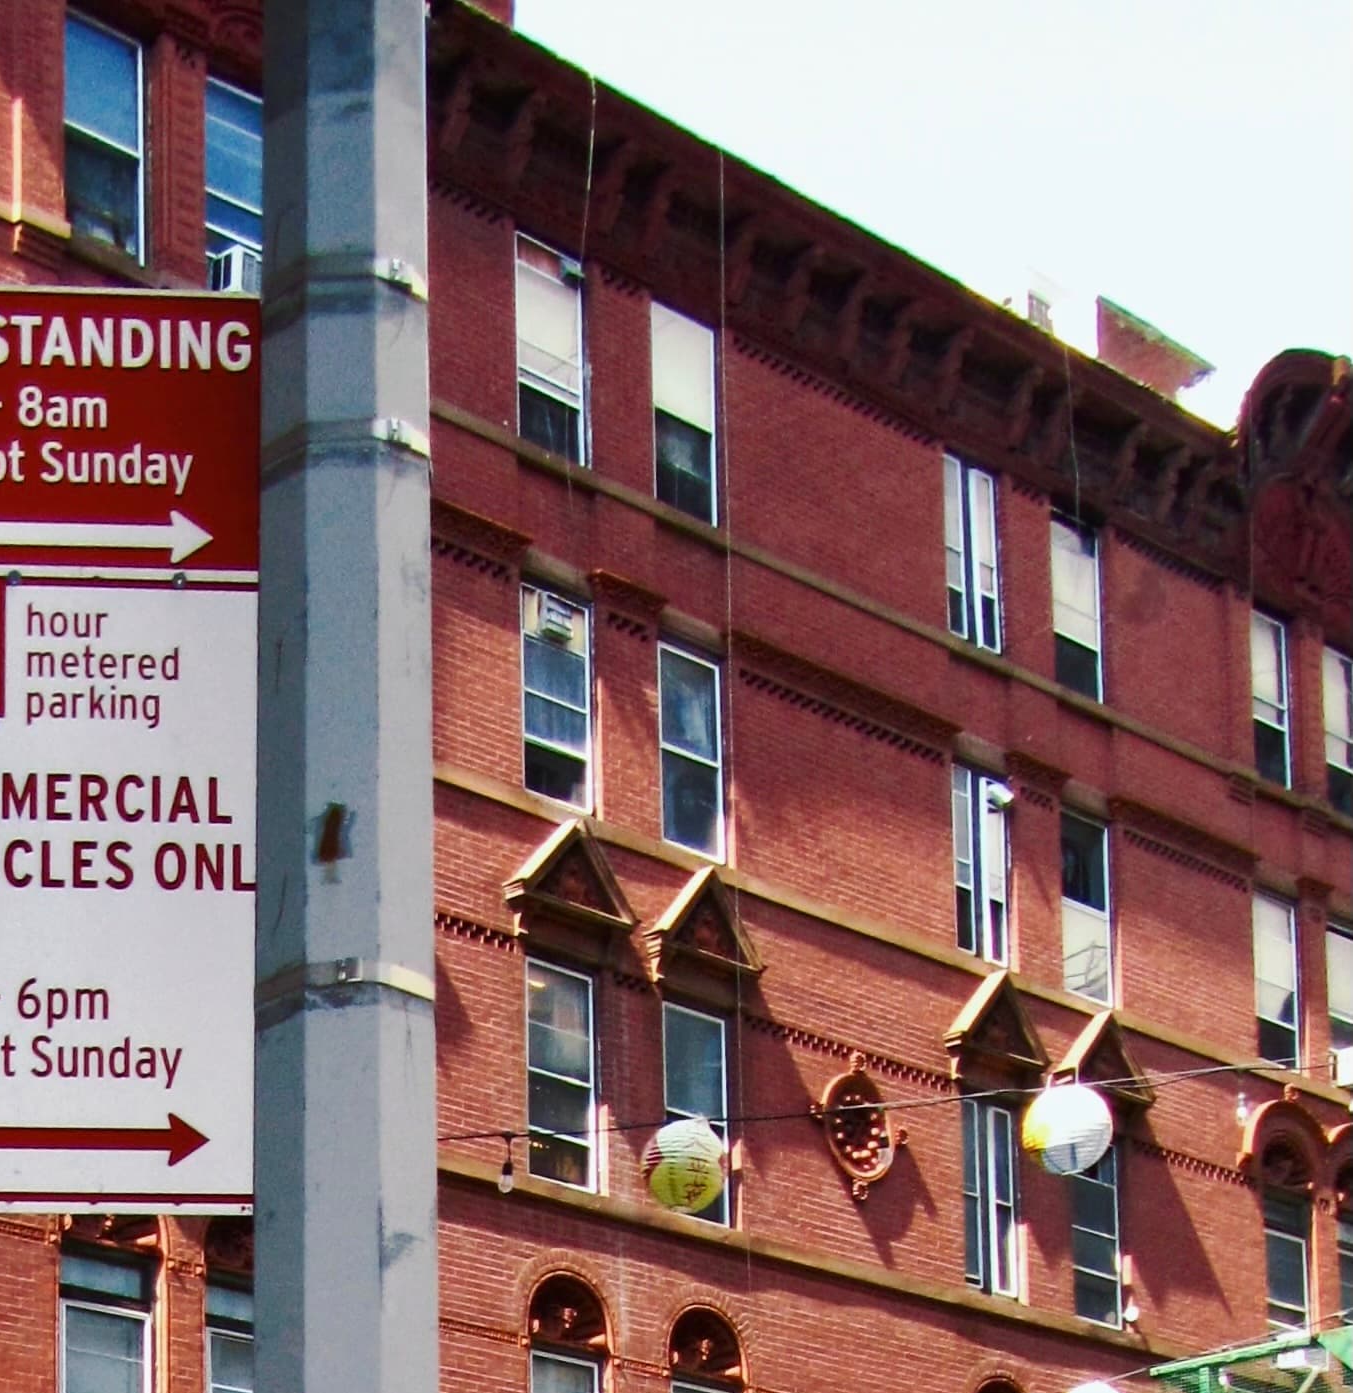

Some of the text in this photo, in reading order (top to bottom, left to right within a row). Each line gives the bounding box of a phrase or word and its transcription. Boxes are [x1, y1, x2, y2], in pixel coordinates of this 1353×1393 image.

[17, 386, 108, 429] 8am
[40, 441, 194, 495] Sunday
[26, 603, 108, 639] hour
[26, 647, 180, 682] metered
[26, 686, 161, 729] parking
[154, 842, 257, 892] ONL
[17, 977, 110, 1029] 6pm
[30, 1035, 183, 1089] Sunday
